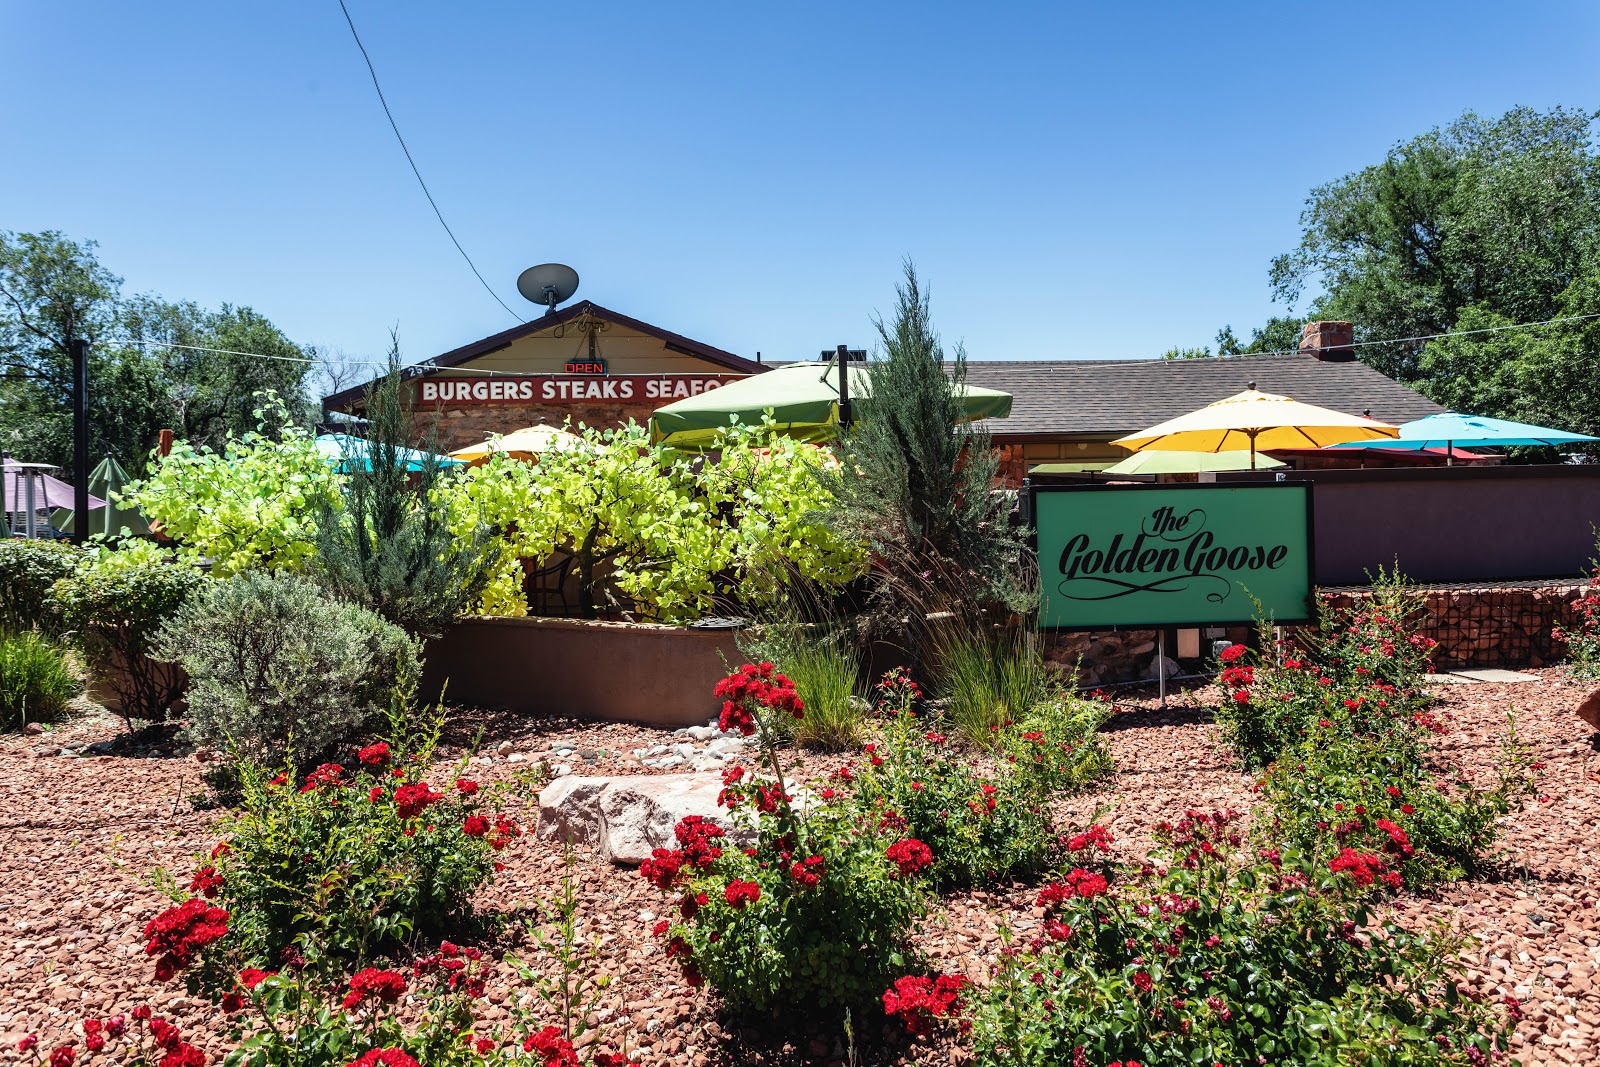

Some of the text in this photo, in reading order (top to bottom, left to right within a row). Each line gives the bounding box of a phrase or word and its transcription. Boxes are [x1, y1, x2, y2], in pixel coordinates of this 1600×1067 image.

[564, 363, 603, 373] OPEN
[423, 380, 738, 400] BURGERS STEAKS SEAFO
[1145, 506, 1200, 537] The
[1058, 530, 1288, 579] Golden Goose
